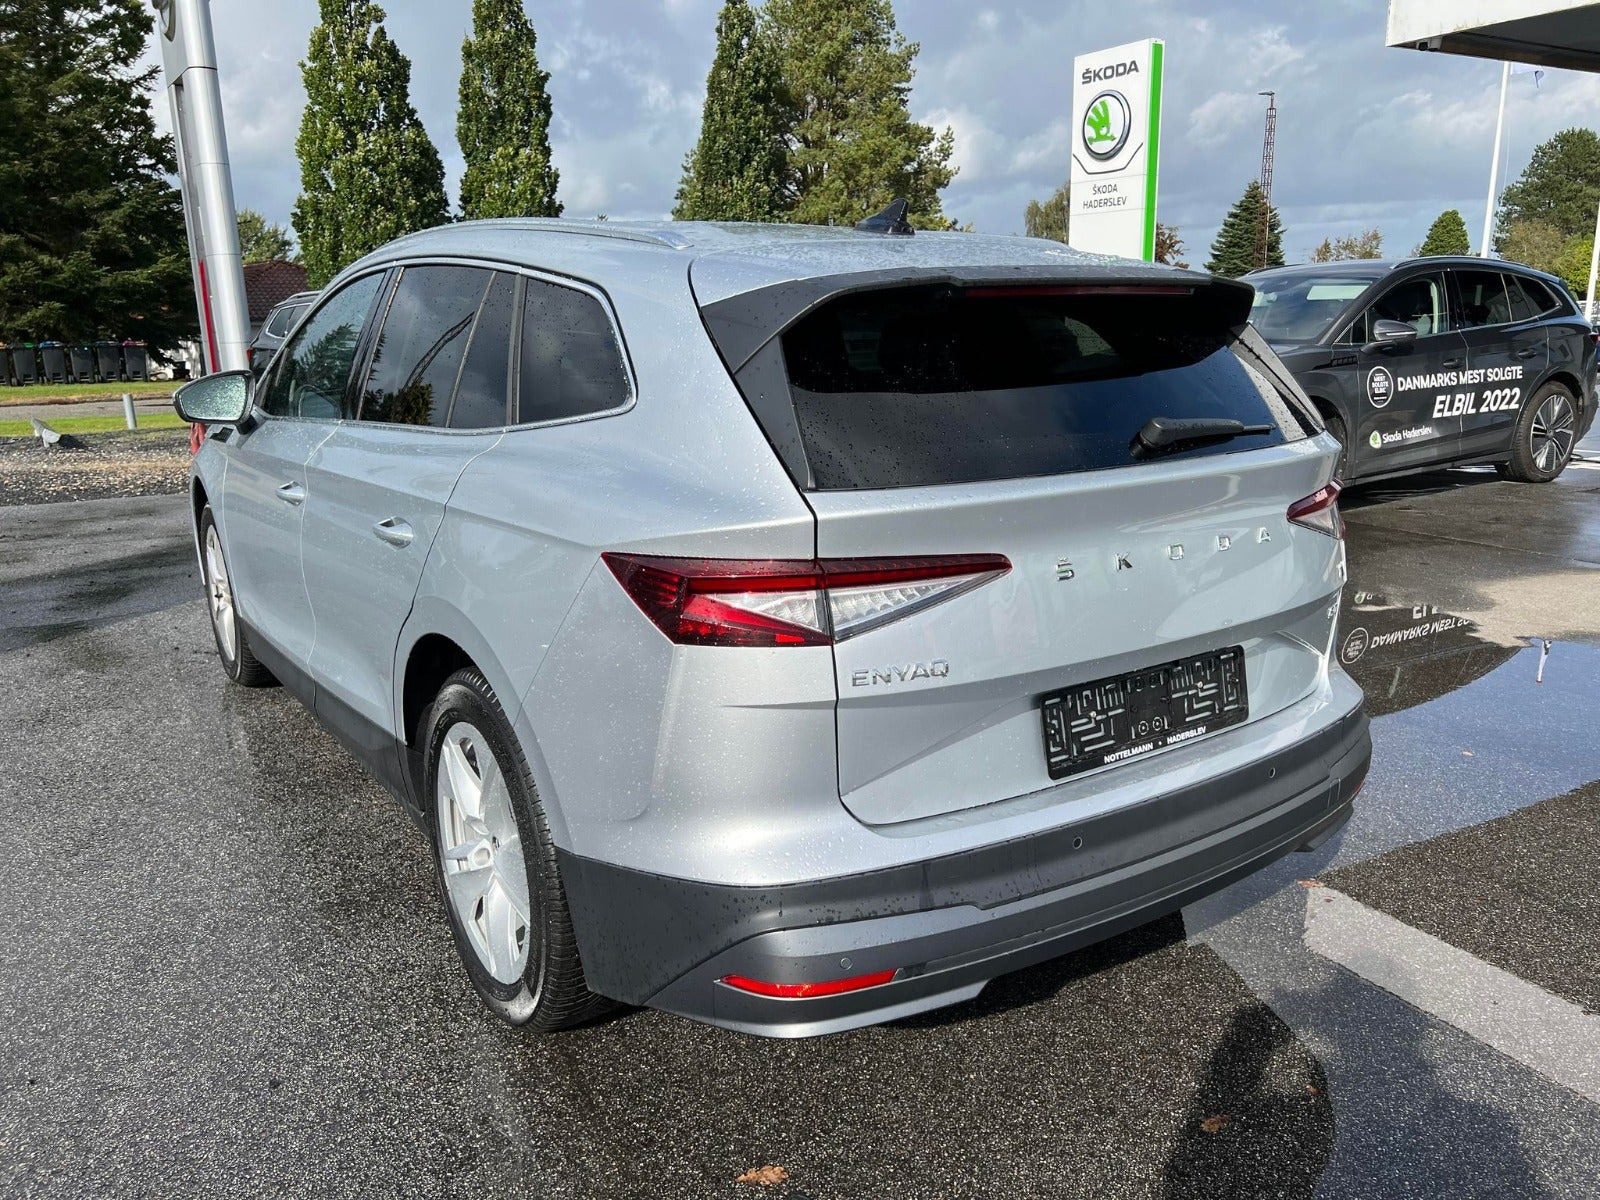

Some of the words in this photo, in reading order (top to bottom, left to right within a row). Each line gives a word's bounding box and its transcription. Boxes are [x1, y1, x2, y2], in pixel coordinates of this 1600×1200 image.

[1082, 60, 1140, 85] ŠKODA
[1092, 183, 1118, 195] ŠKODA
[1083, 196, 1127, 209] HADERSLEV
[1397, 372, 1458, 392] DANMARKS
[1459, 369, 1488, 385] MEST
[1488, 365, 1523, 383] SOLGTE
[1432, 392, 1477, 419] ELBIL
[1479, 387, 1521, 413] 2022
[1402, 425, 1433, 439] Haderslev
[852, 658, 950, 687] ENYAQ
[1103, 742, 1154, 764] NOTTELMANN
[1166, 725, 1207, 745] HADERSLEV
